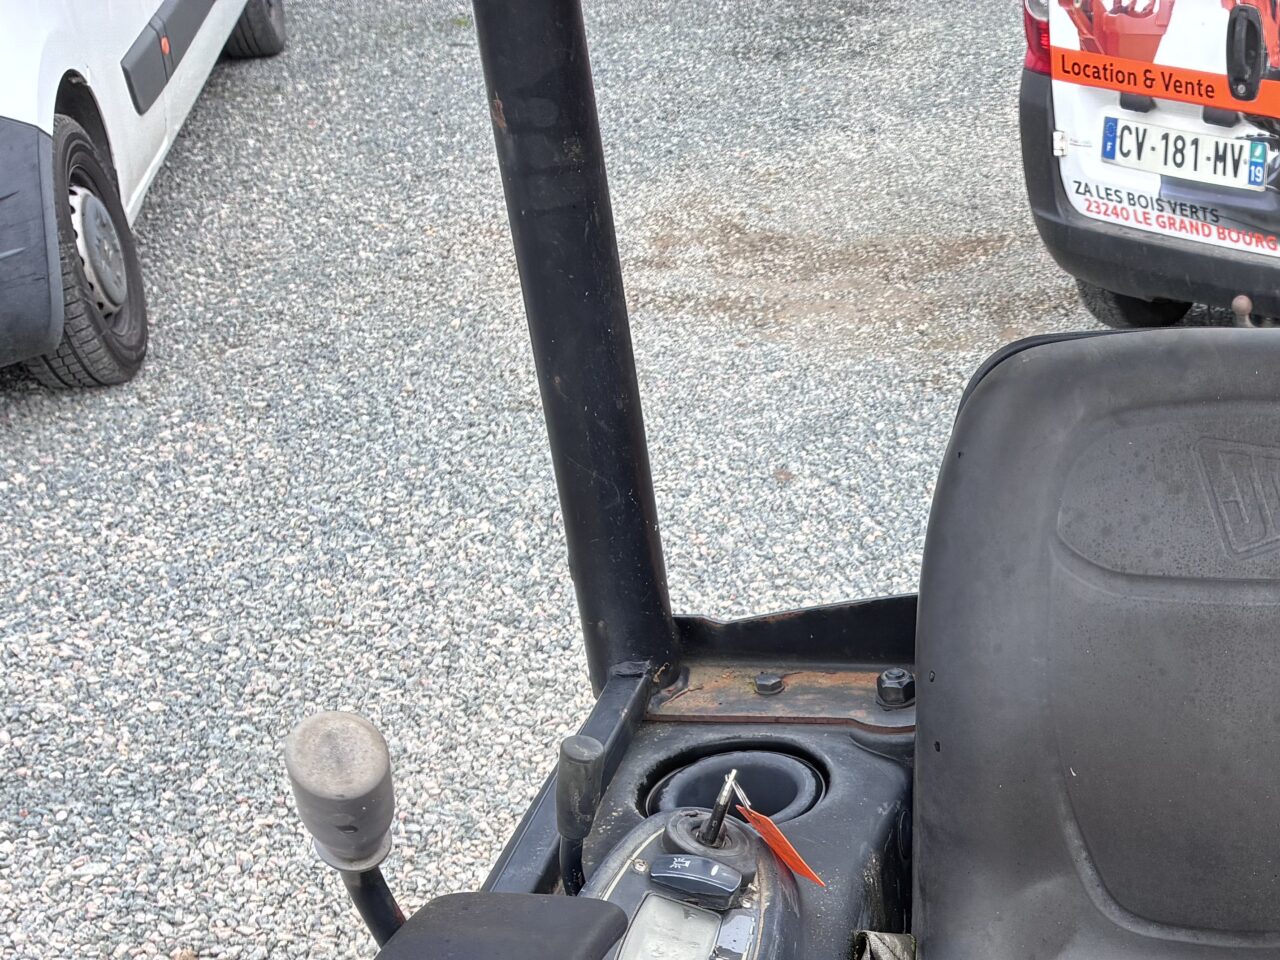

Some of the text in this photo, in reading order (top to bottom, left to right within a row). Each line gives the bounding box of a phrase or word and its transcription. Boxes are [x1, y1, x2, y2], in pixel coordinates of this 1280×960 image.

[1061, 54, 1215, 99] Location & Vente
[1250, 165, 1264, 182] 19
[1073, 180, 1220, 223] ZA LES BOIS VERTS
[1084, 198, 1279, 251] 23240 LE GRAND BOURG
